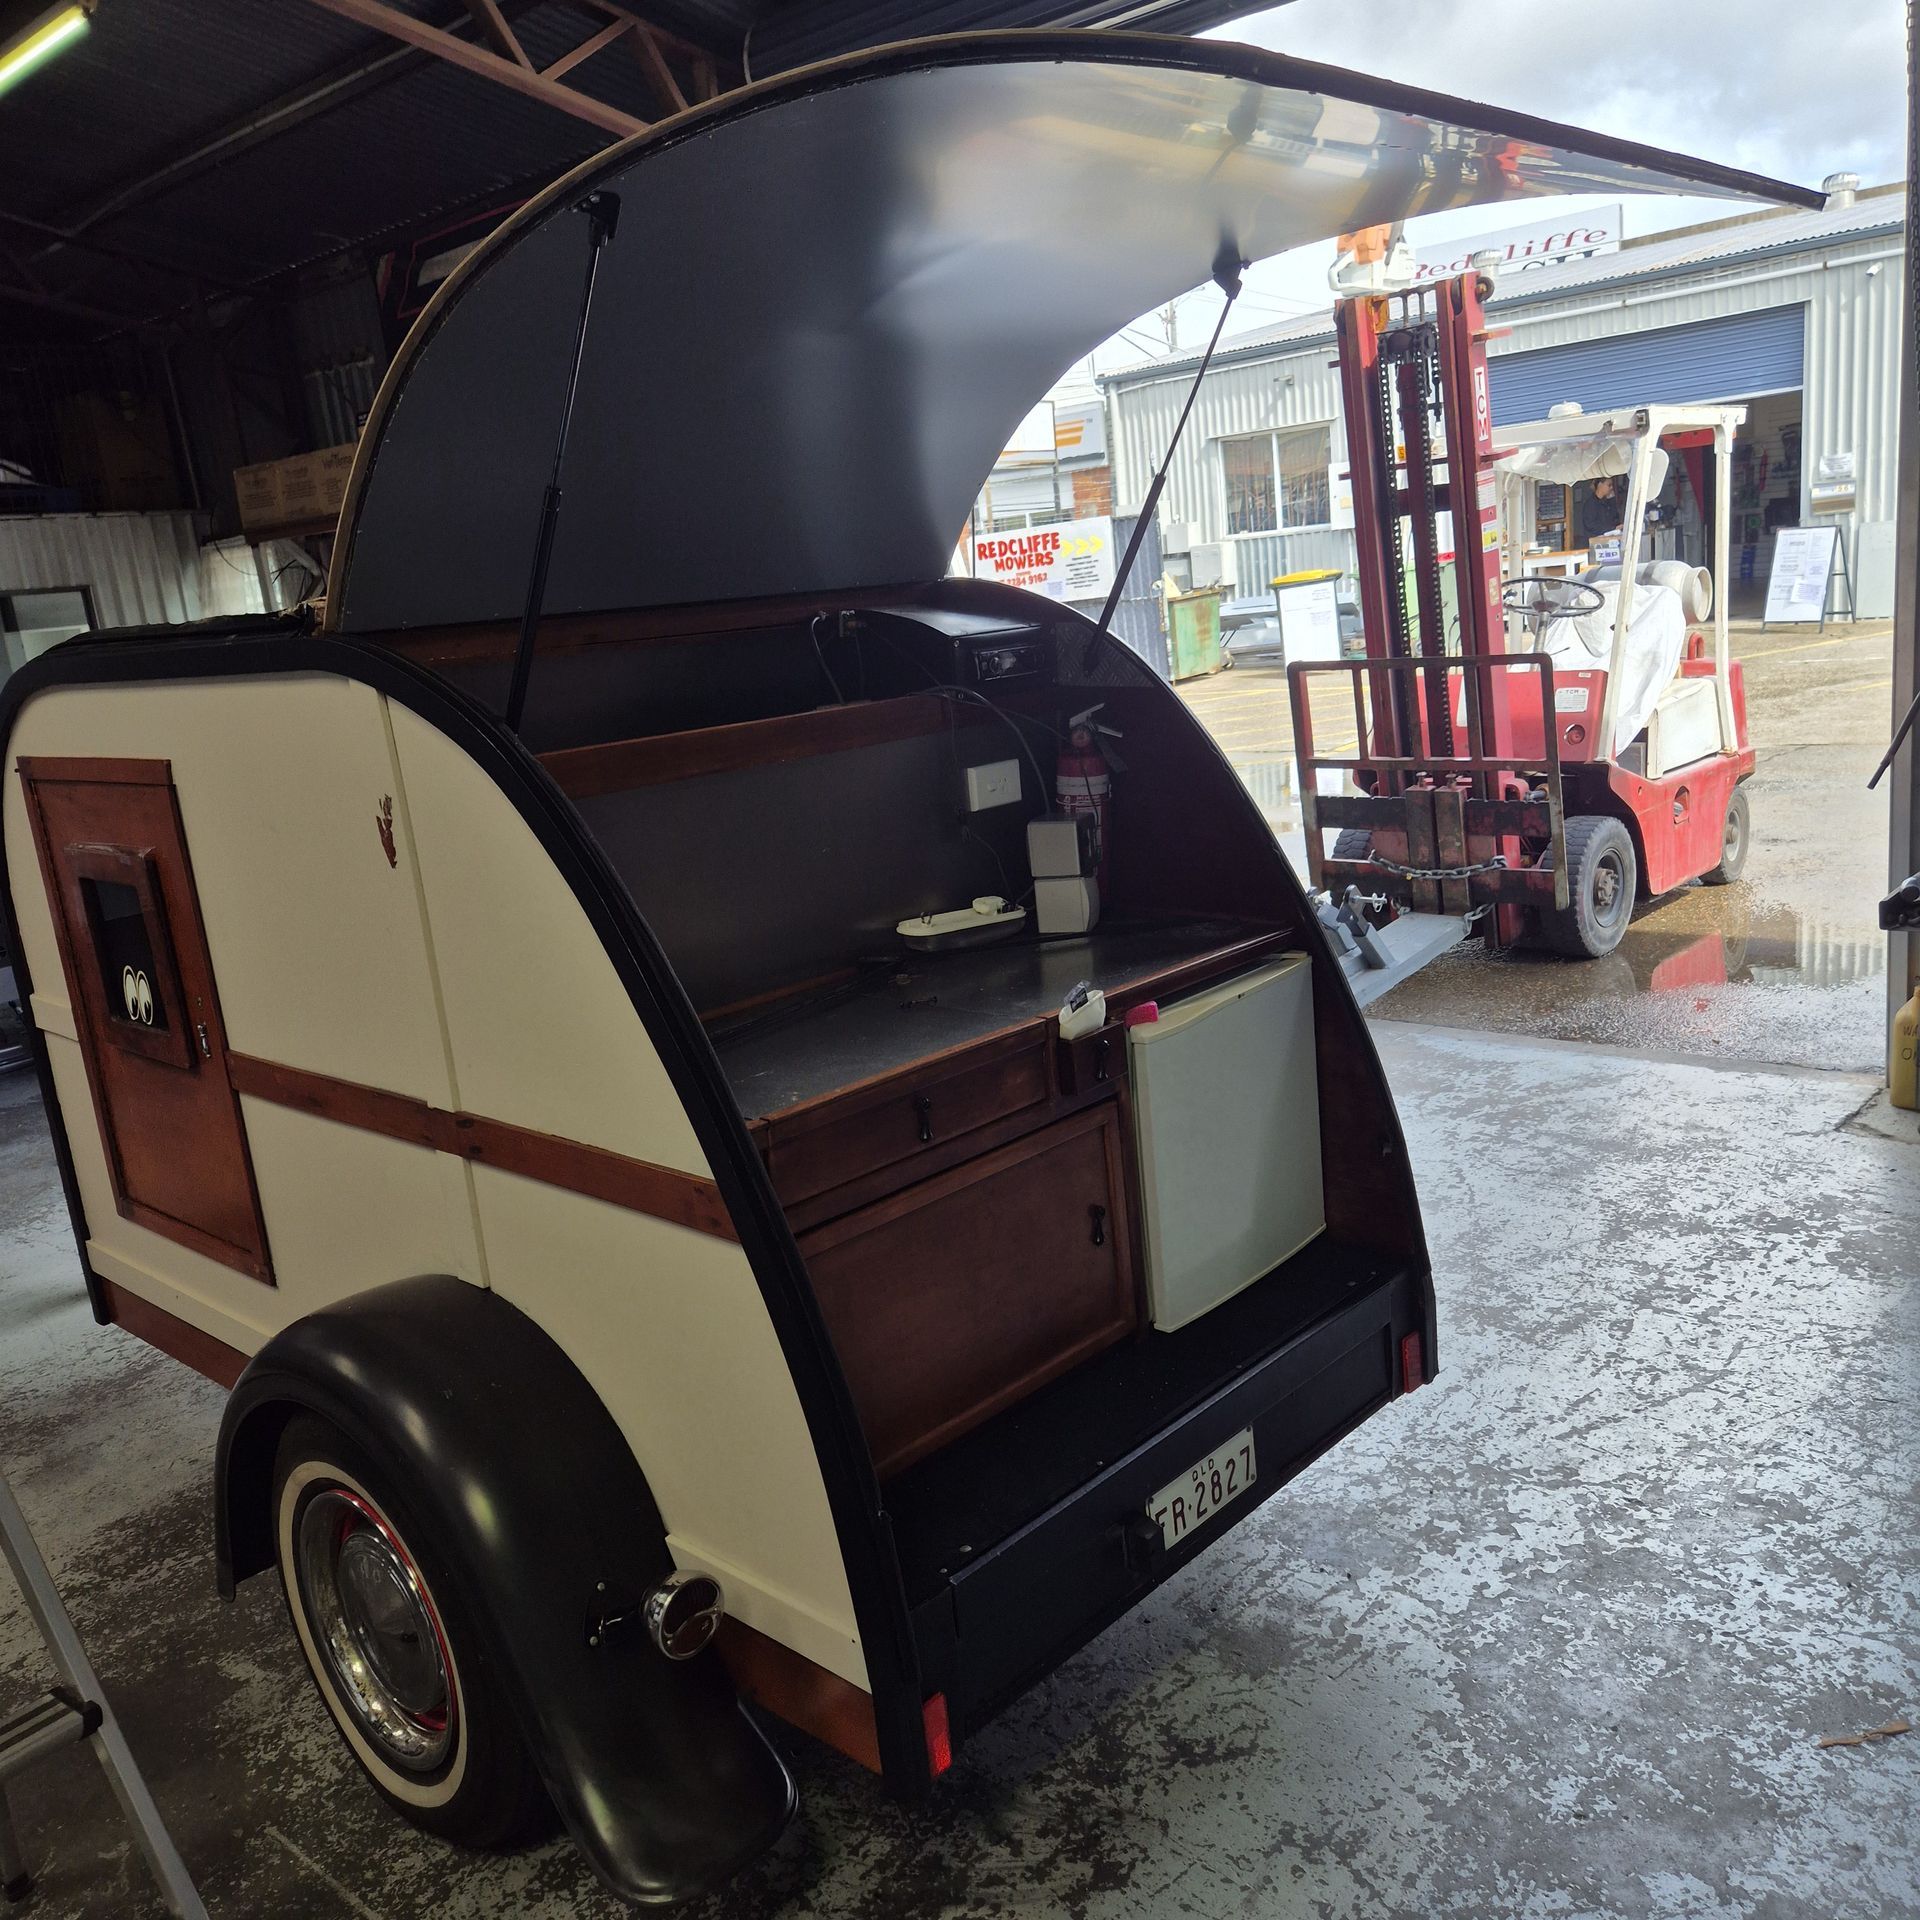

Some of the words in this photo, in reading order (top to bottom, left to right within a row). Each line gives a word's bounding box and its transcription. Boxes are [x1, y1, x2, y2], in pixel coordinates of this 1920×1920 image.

[1476, 371, 1488, 437] TCM
[977, 532, 1061, 561] REDCLIFFE
[994, 552, 1054, 573] MOWERS
[1192, 1458, 1215, 1482] QLD
